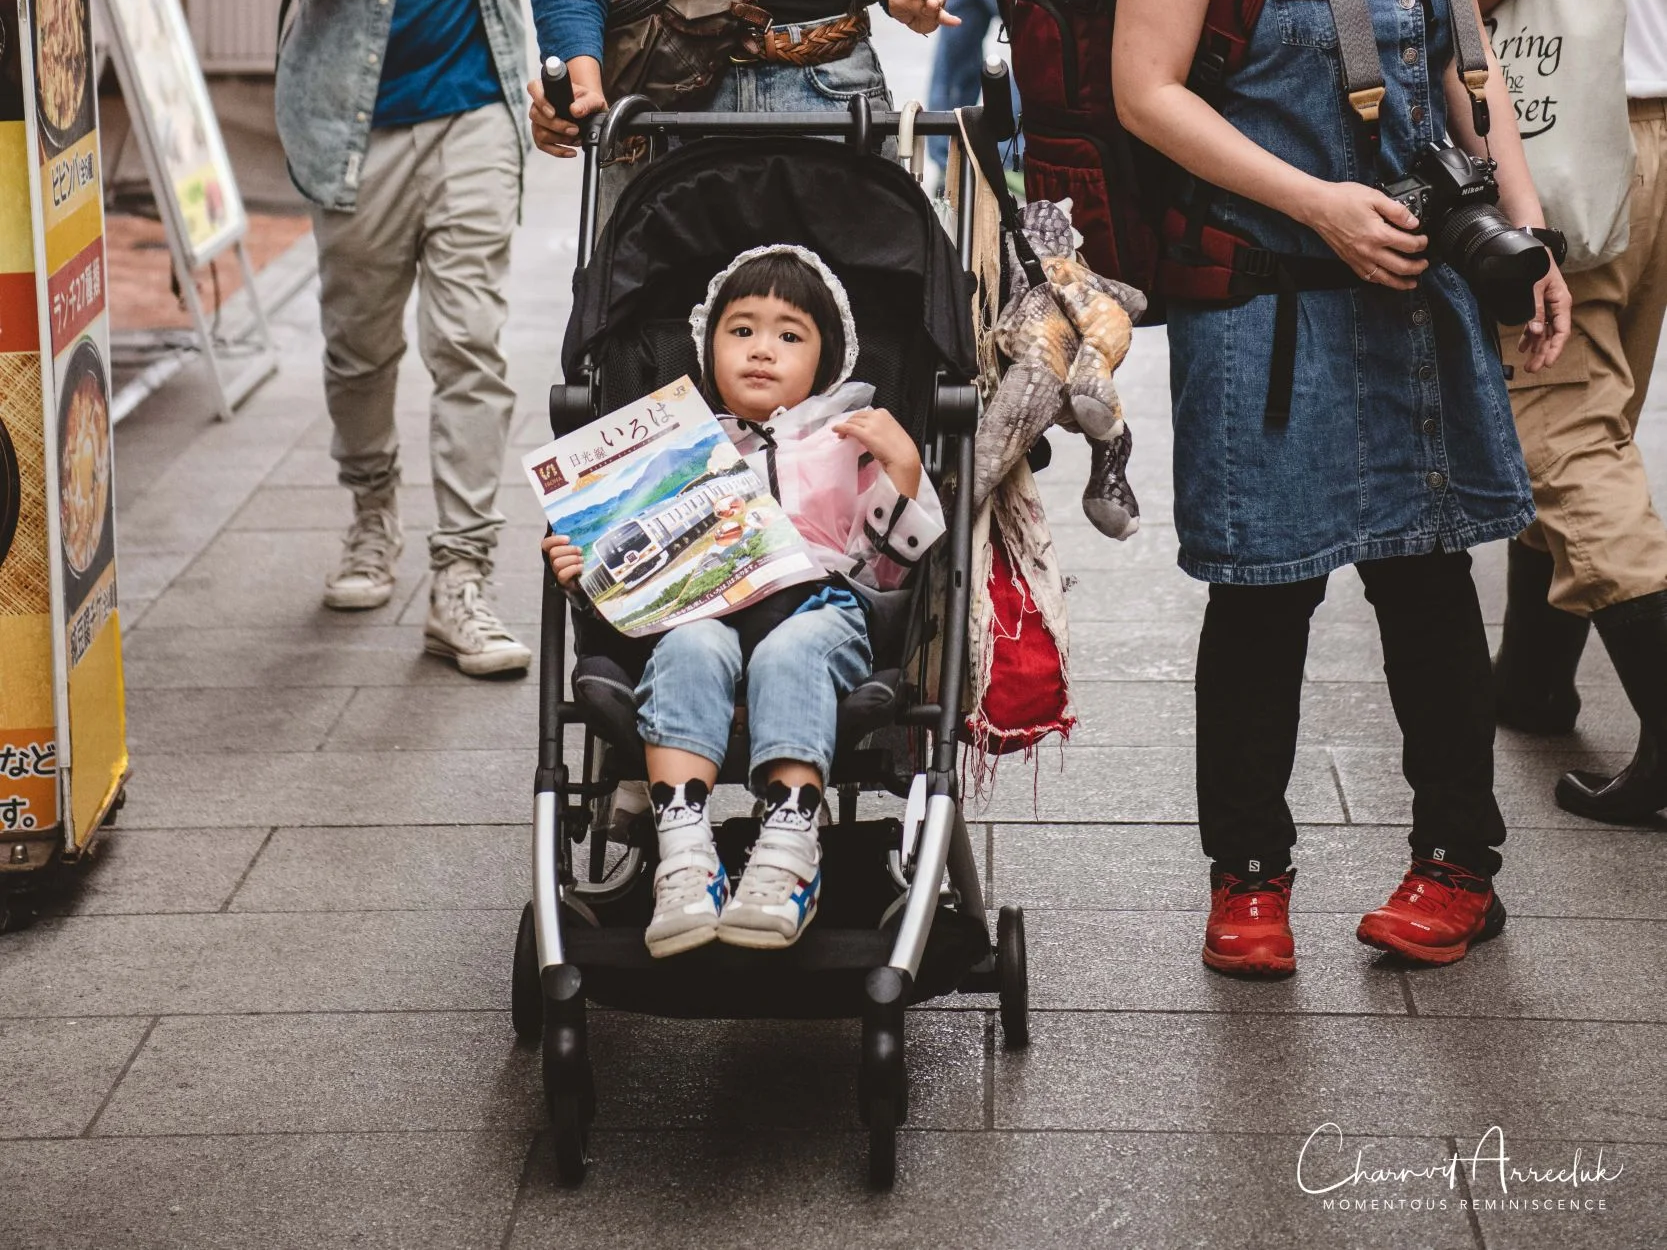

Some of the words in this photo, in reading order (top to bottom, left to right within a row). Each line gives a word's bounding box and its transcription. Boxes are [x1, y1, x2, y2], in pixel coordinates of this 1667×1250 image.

[1513, 96, 1558, 123] set
[1461, 184, 1485, 196] Nikon
[600, 402, 675, 447] いろは
